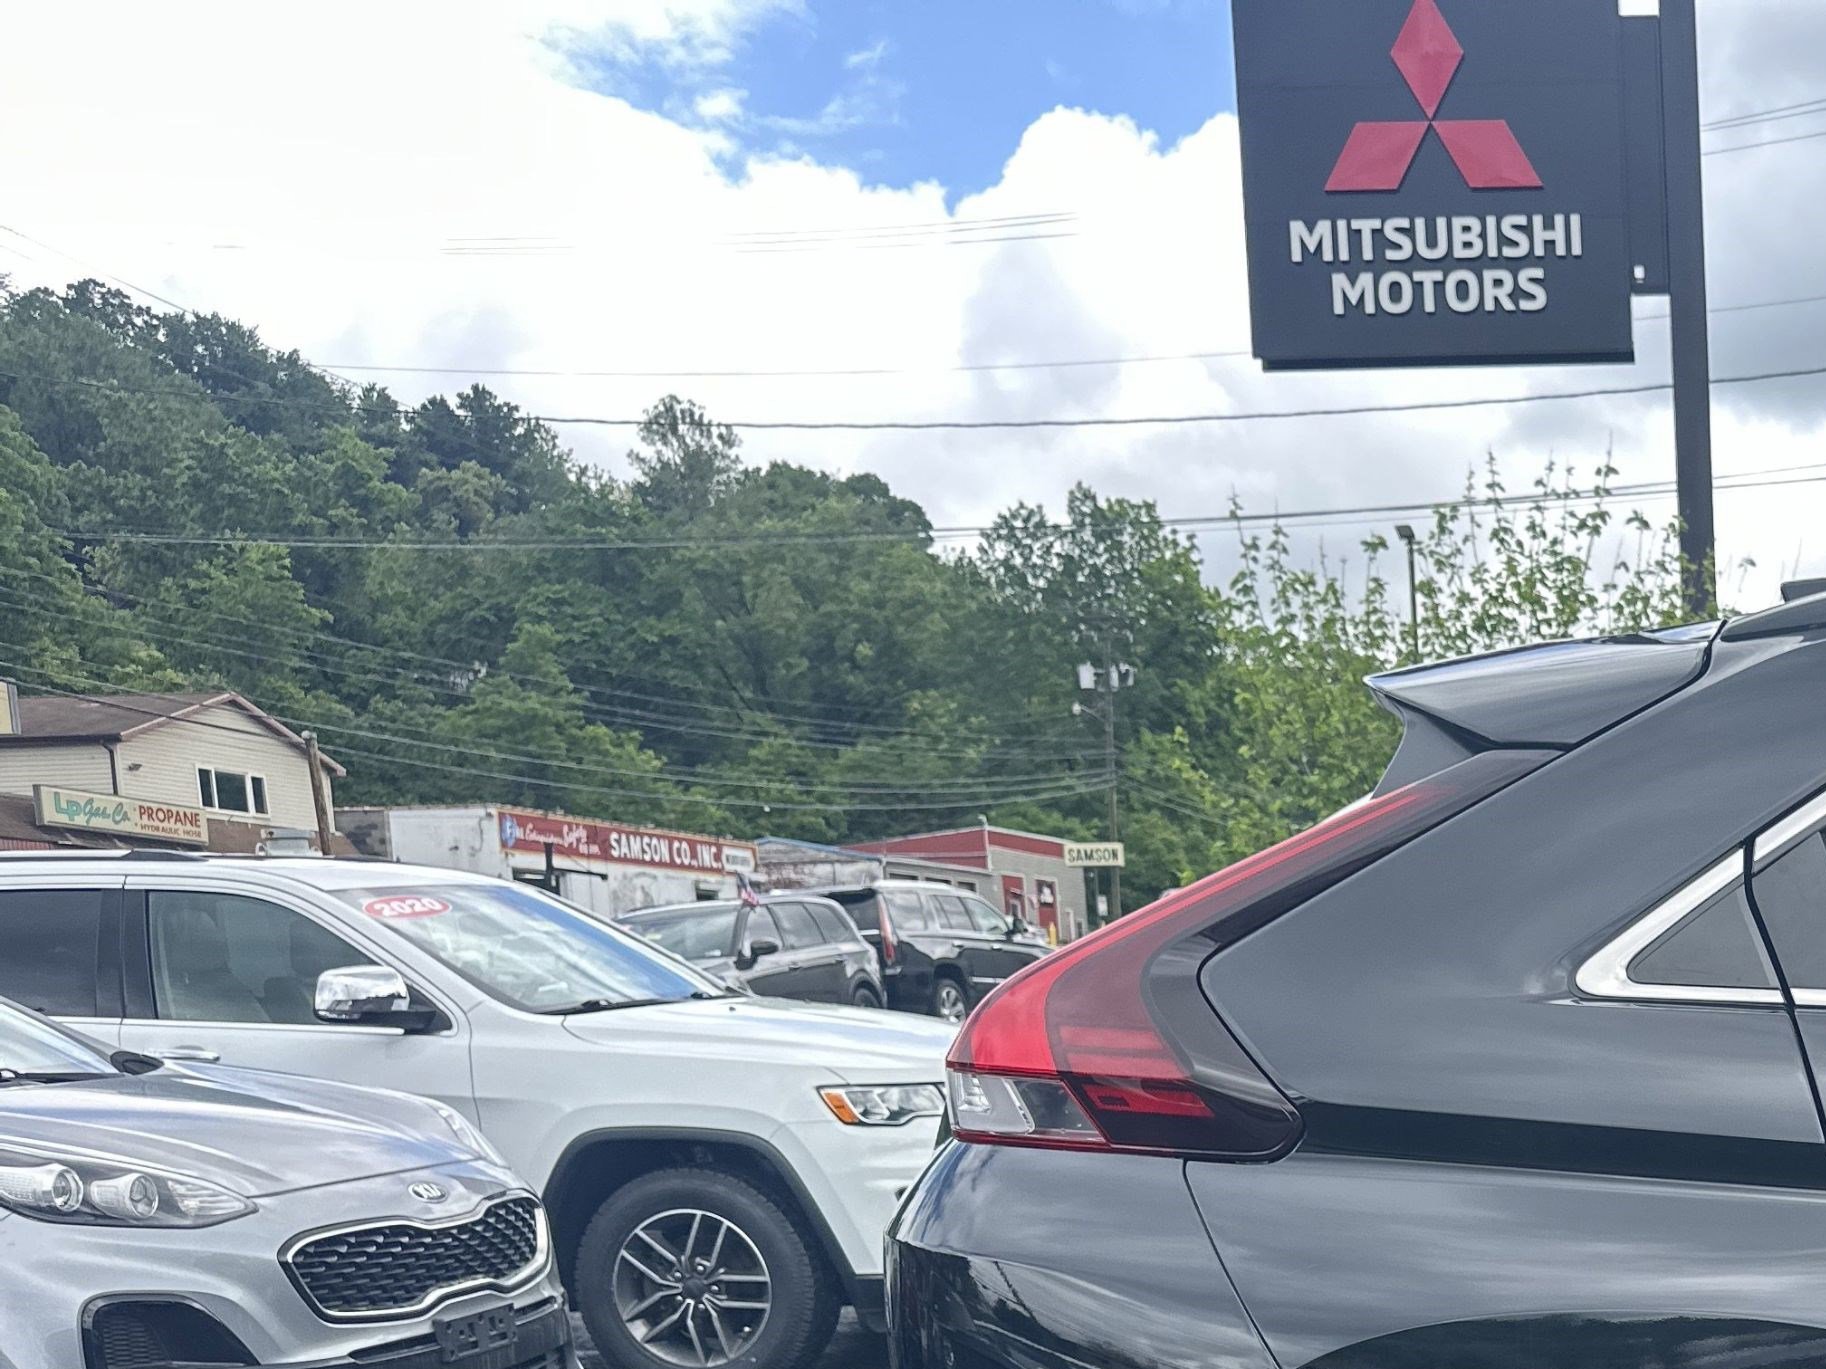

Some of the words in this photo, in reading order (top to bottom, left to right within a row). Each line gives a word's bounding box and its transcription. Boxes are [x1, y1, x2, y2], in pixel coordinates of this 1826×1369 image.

[1289, 213, 1583, 263] MITSUBISHI
[1331, 266, 1548, 316] MOTORS
[138, 804, 201, 828] PROPANE
[609, 831, 671, 864] SAMSON
[1067, 847, 1119, 862] SAMSON
[373, 897, 444, 917] 2020
